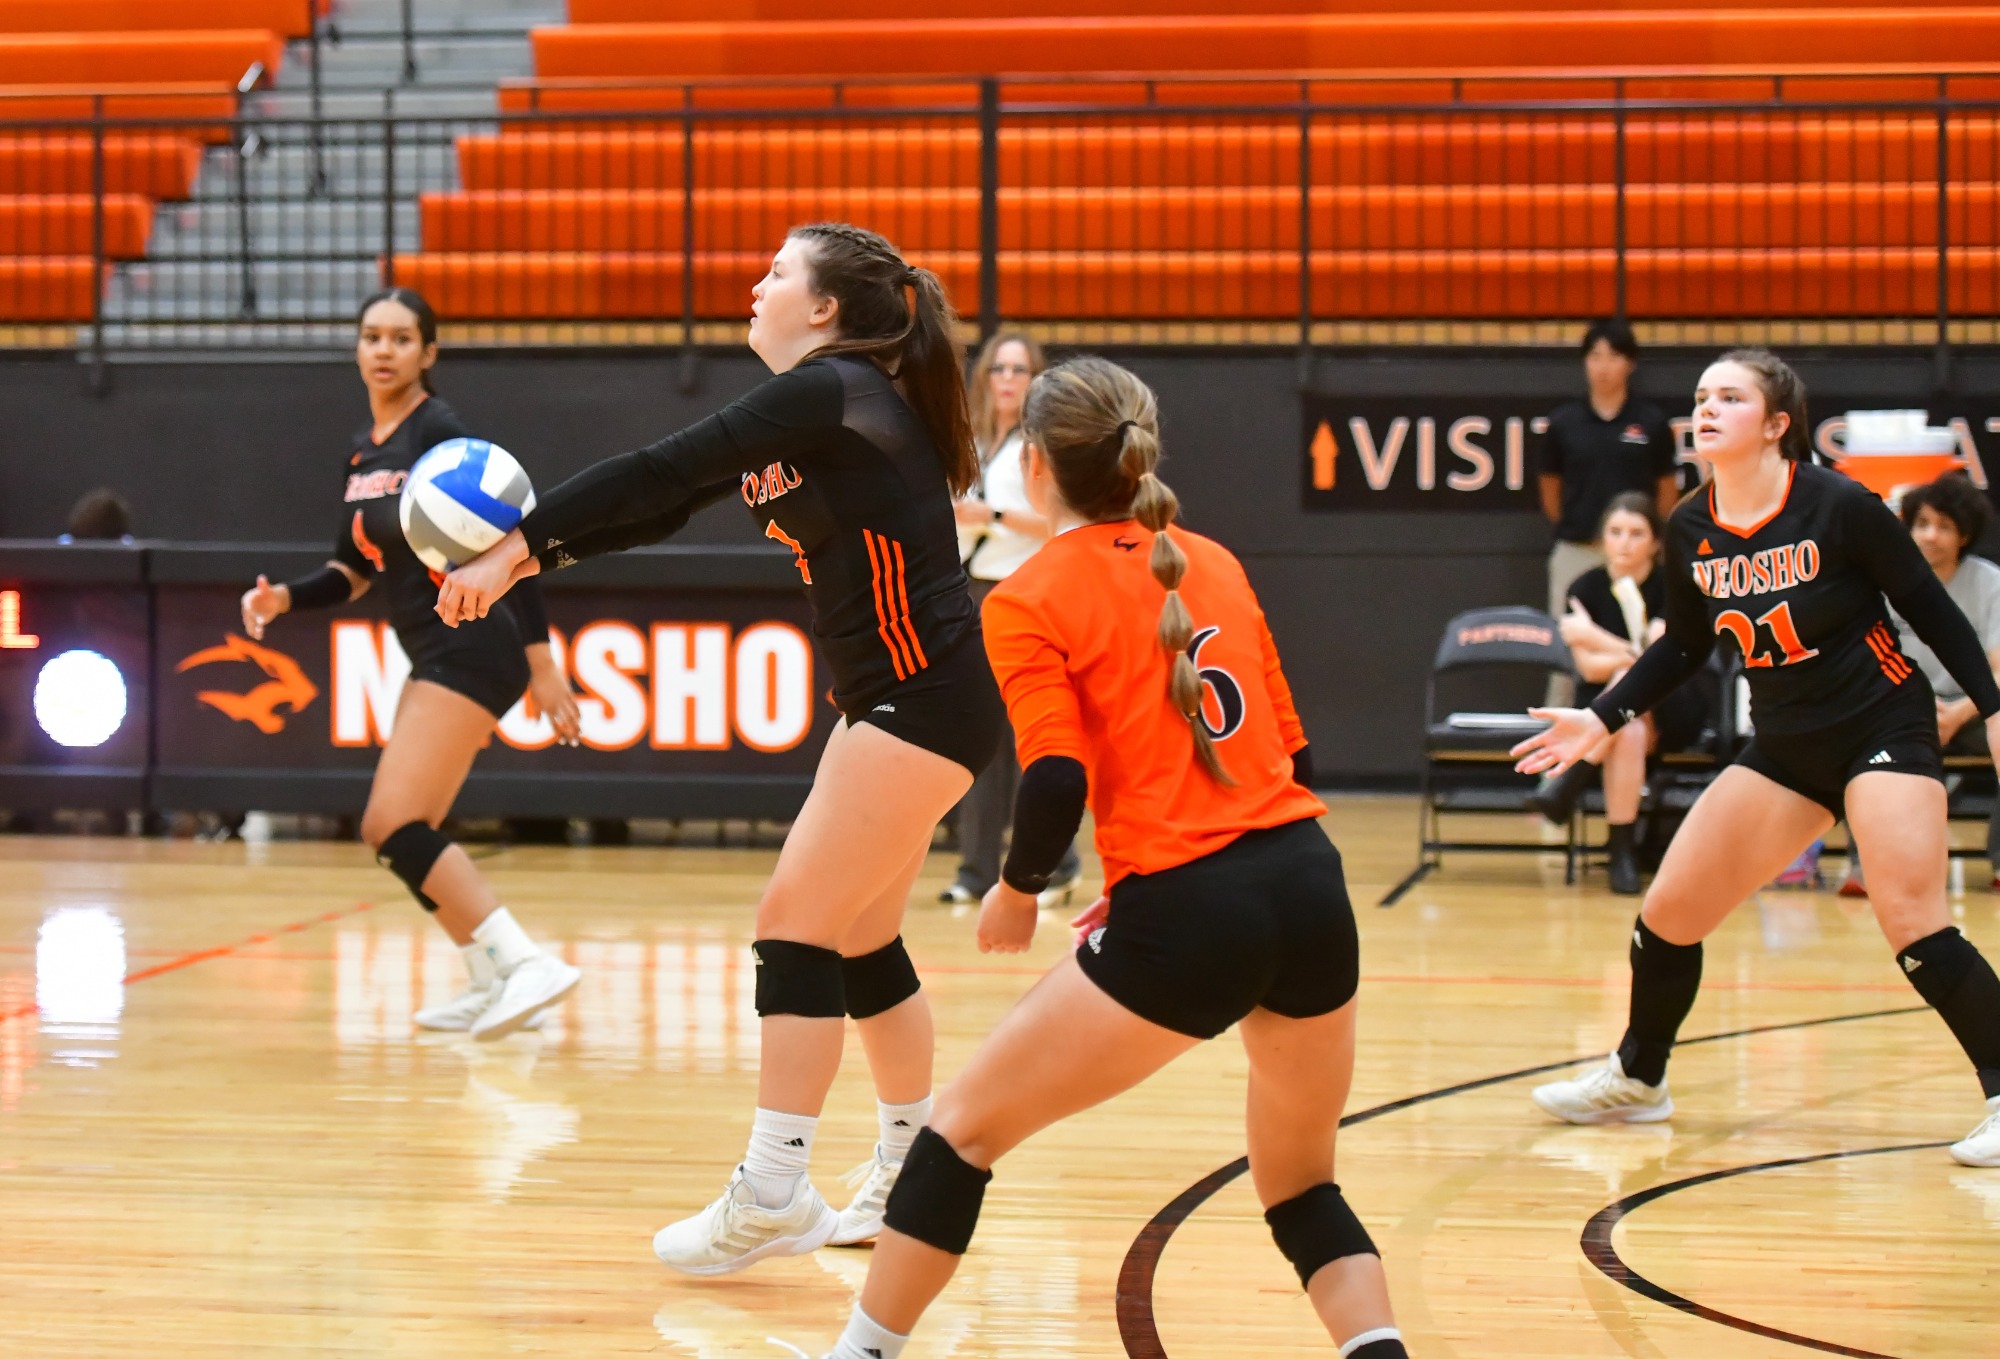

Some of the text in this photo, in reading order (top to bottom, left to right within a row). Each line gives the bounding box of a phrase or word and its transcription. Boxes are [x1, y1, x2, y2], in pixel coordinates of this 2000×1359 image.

[1692, 539, 1820, 598] NEOSHO
[1715, 600, 1819, 668] 21
[1181, 626, 1246, 742] 6
